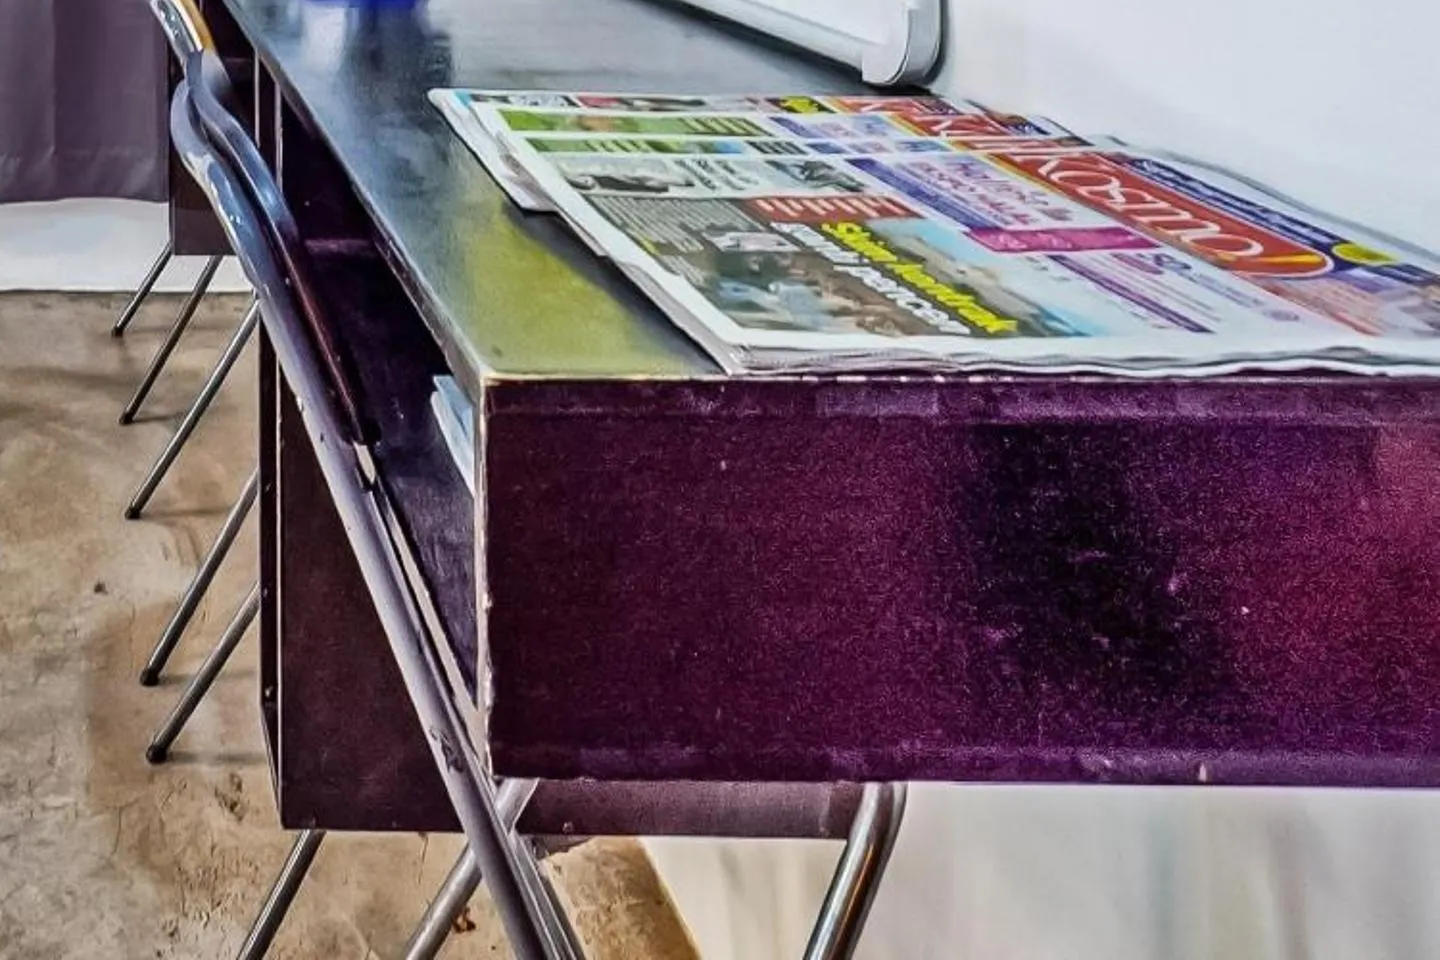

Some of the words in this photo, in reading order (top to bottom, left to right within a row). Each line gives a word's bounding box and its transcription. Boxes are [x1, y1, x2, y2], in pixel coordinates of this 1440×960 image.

[770, 221, 870, 265] ganti
[833, 265, 972, 335] pencen
[821, 221, 898, 263] Skim
[885, 263, 1018, 334] kontrak
